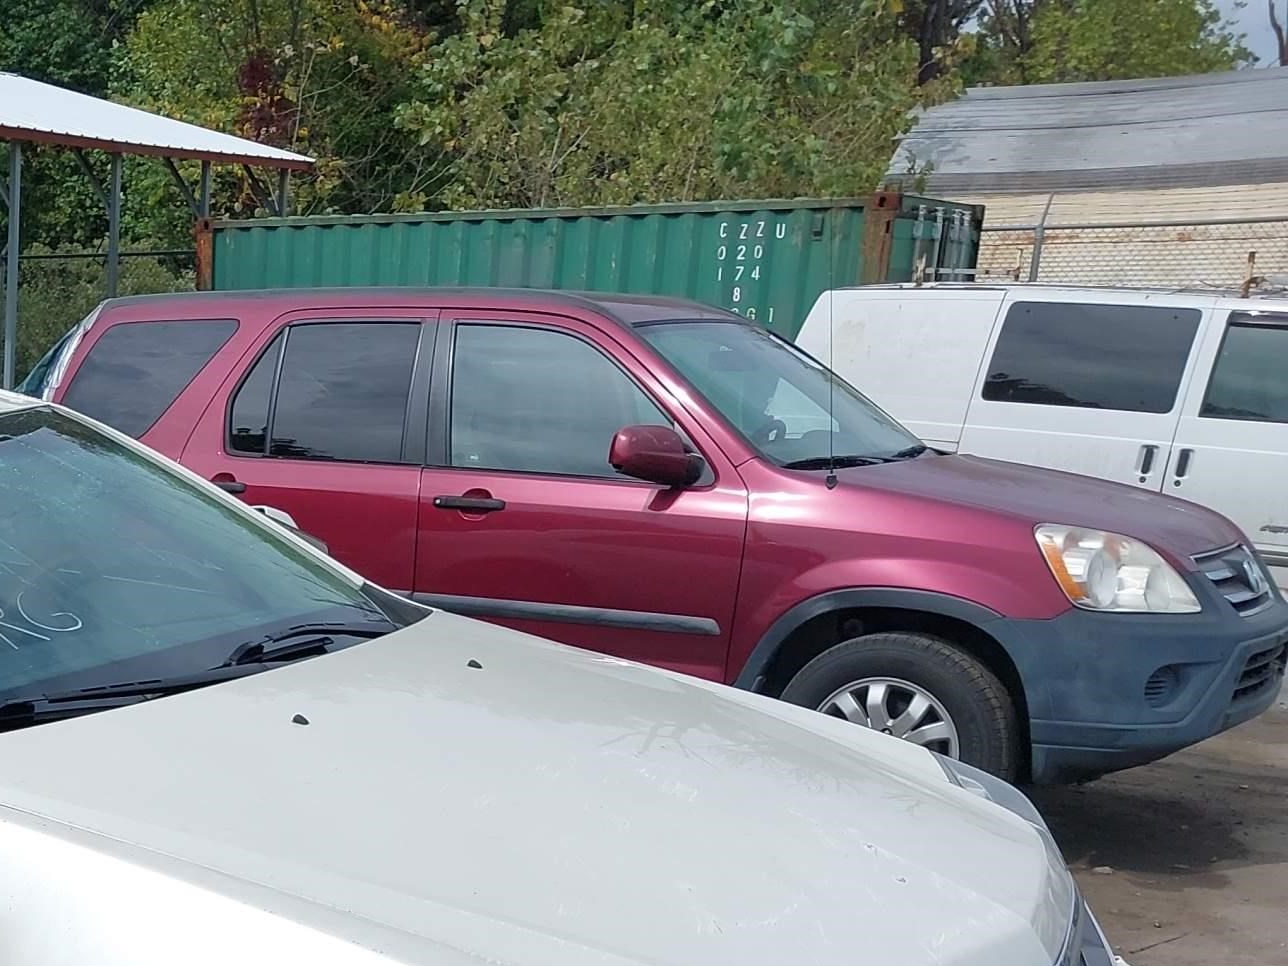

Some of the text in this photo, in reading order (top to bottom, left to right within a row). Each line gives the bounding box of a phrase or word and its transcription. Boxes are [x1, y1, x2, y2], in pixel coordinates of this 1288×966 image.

[719, 221, 786, 239] CZZU
[717, 244, 763, 260] 020
[717, 265, 761, 281] 174
[732, 286, 741, 302] 8
